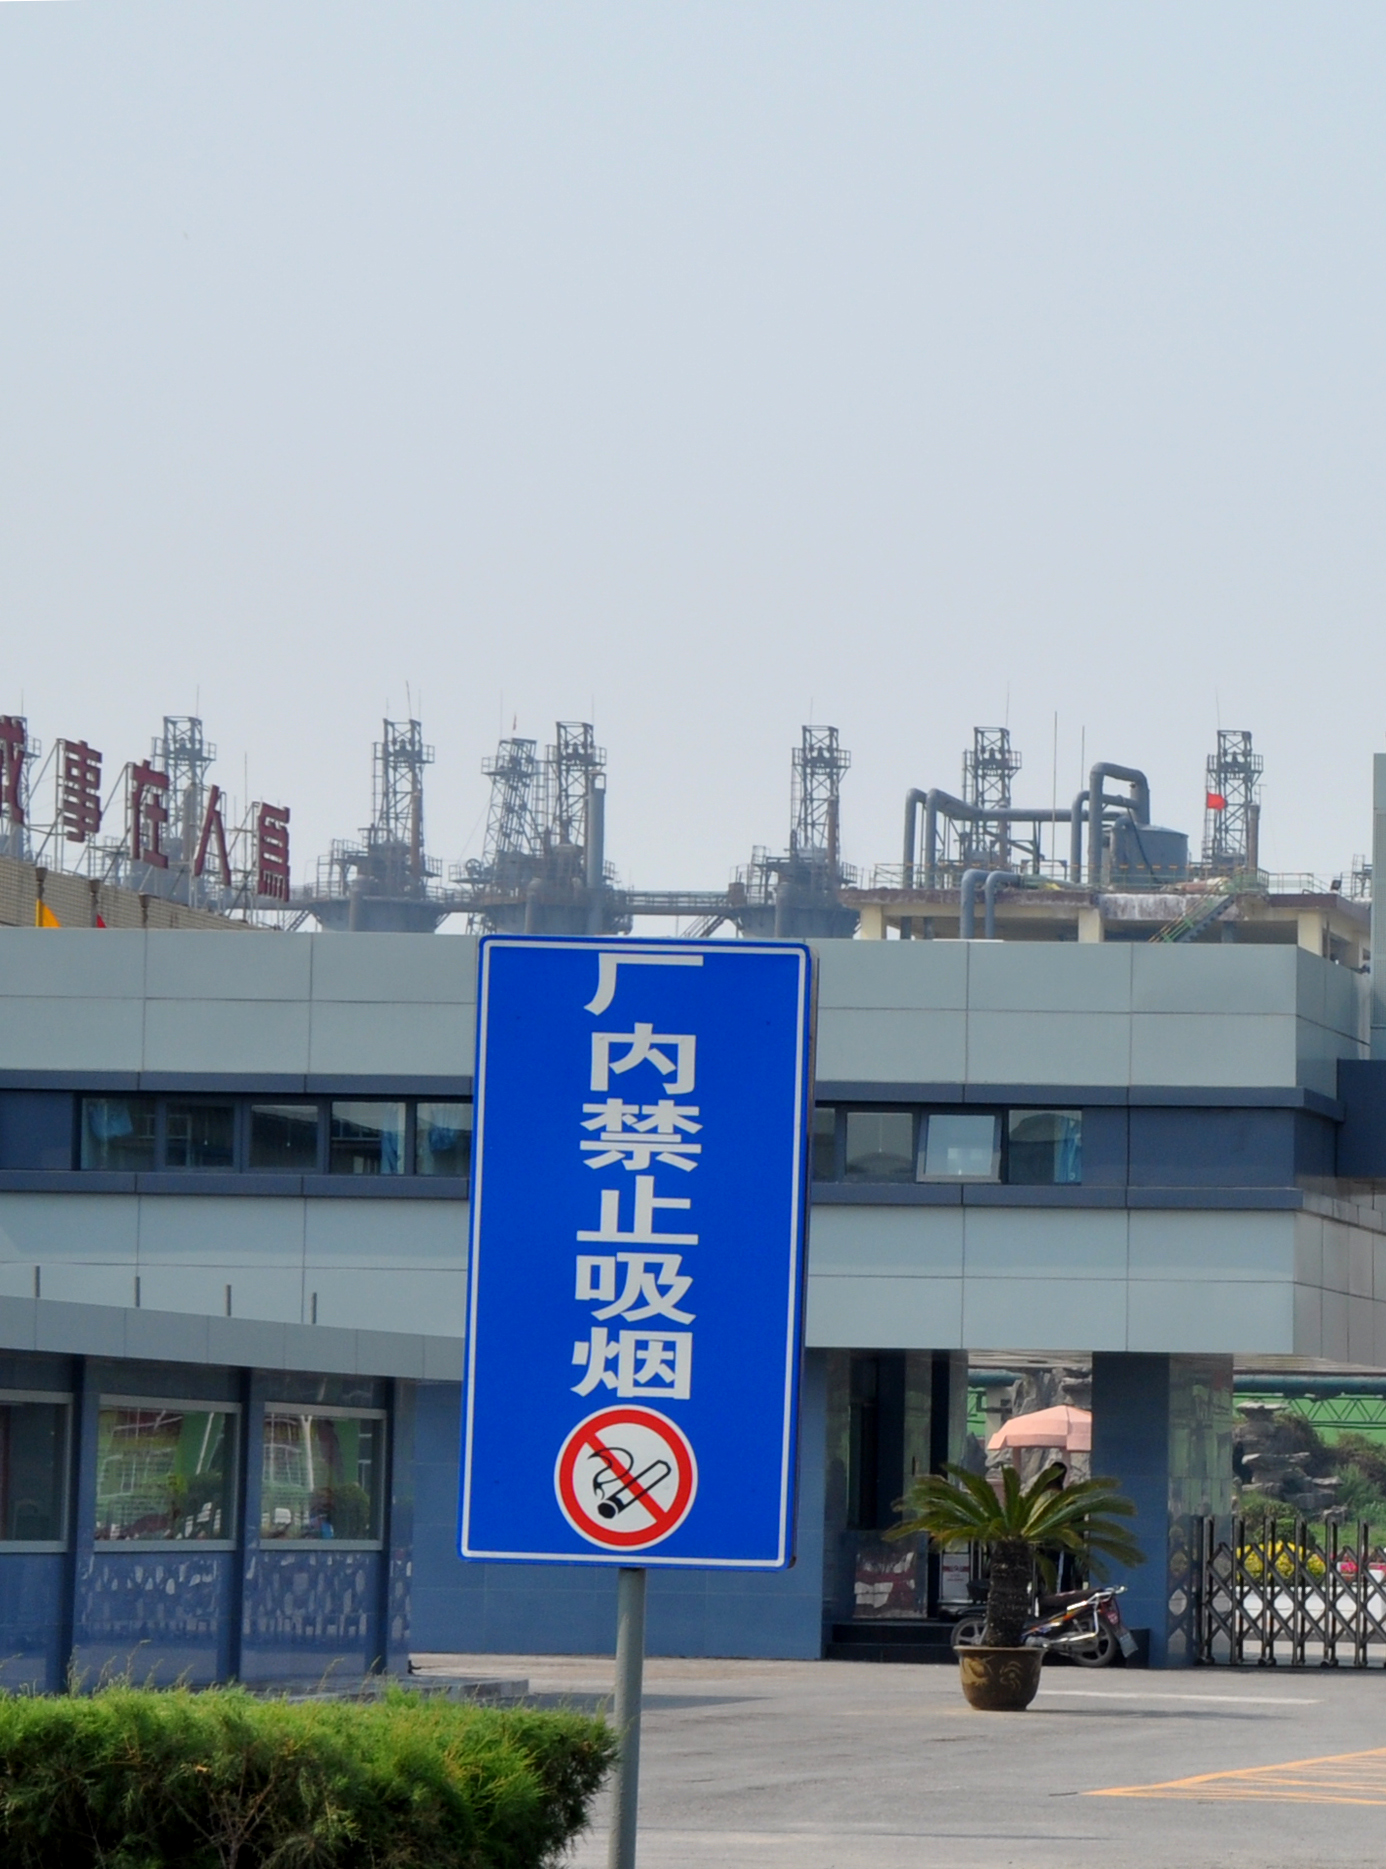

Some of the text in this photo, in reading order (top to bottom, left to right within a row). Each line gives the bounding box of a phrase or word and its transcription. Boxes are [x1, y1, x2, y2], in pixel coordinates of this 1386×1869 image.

[571, 952, 704, 1400] 厂内禁止吸烟
